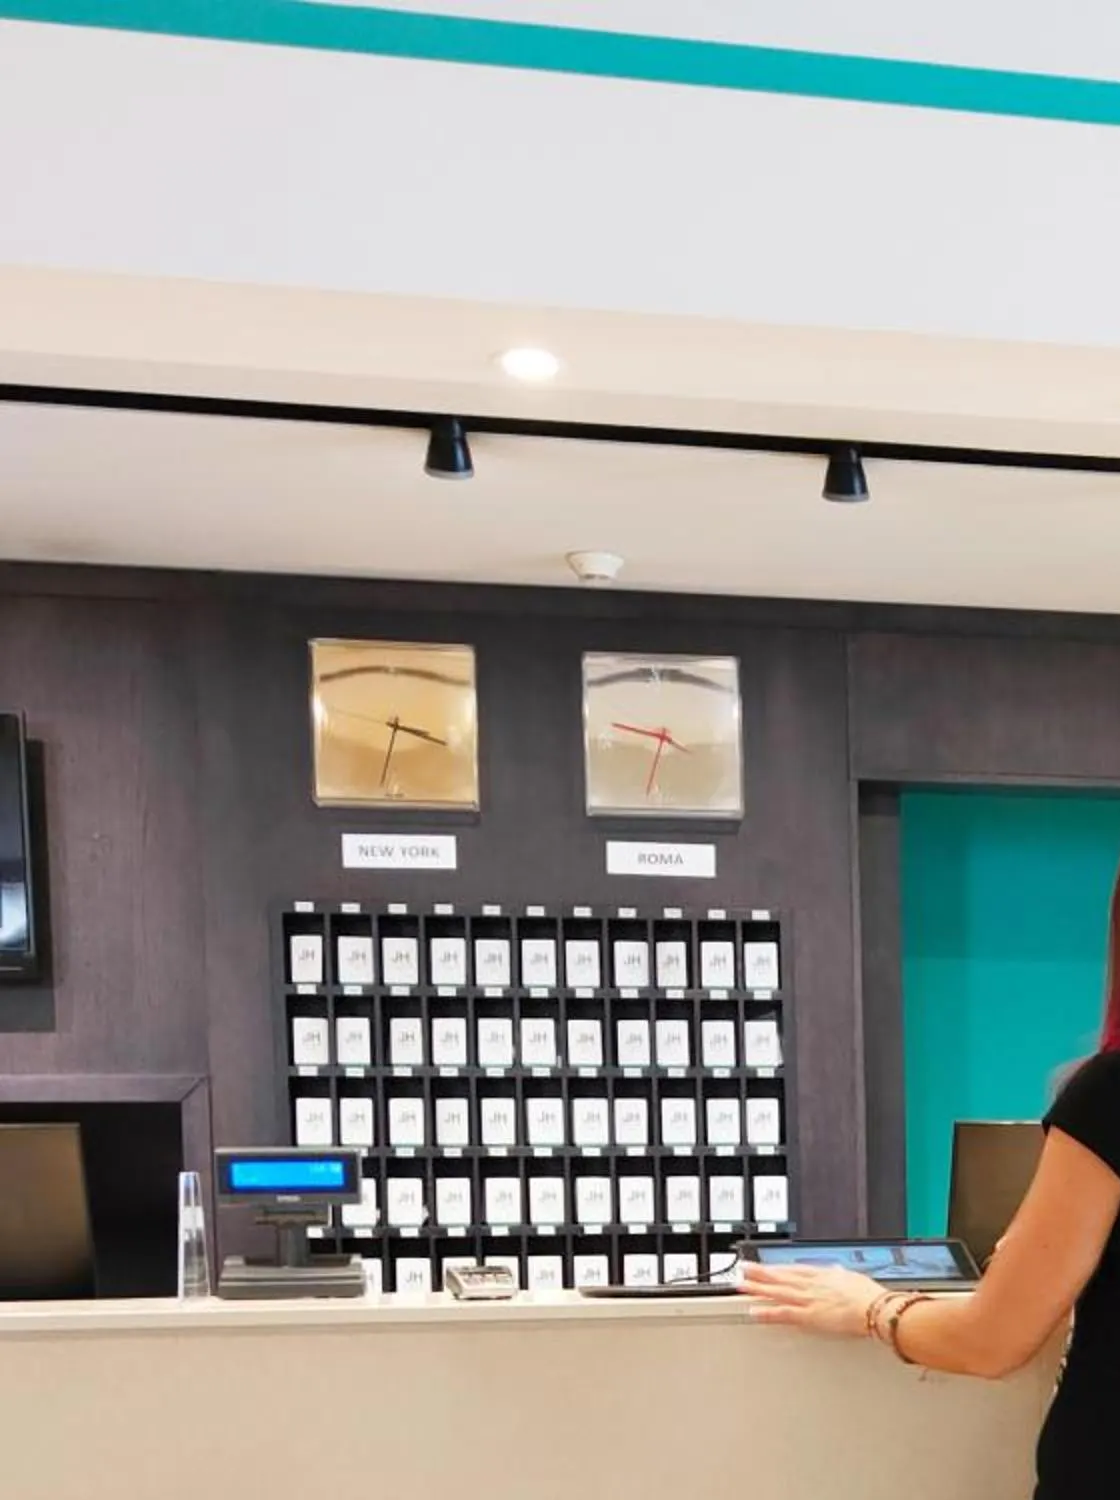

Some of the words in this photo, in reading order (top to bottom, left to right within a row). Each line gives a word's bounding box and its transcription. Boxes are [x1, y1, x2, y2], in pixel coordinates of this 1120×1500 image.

[358, 845, 394, 857] NEW
[400, 846, 440, 858] YORK
[638, 853, 684, 865] ROMA
